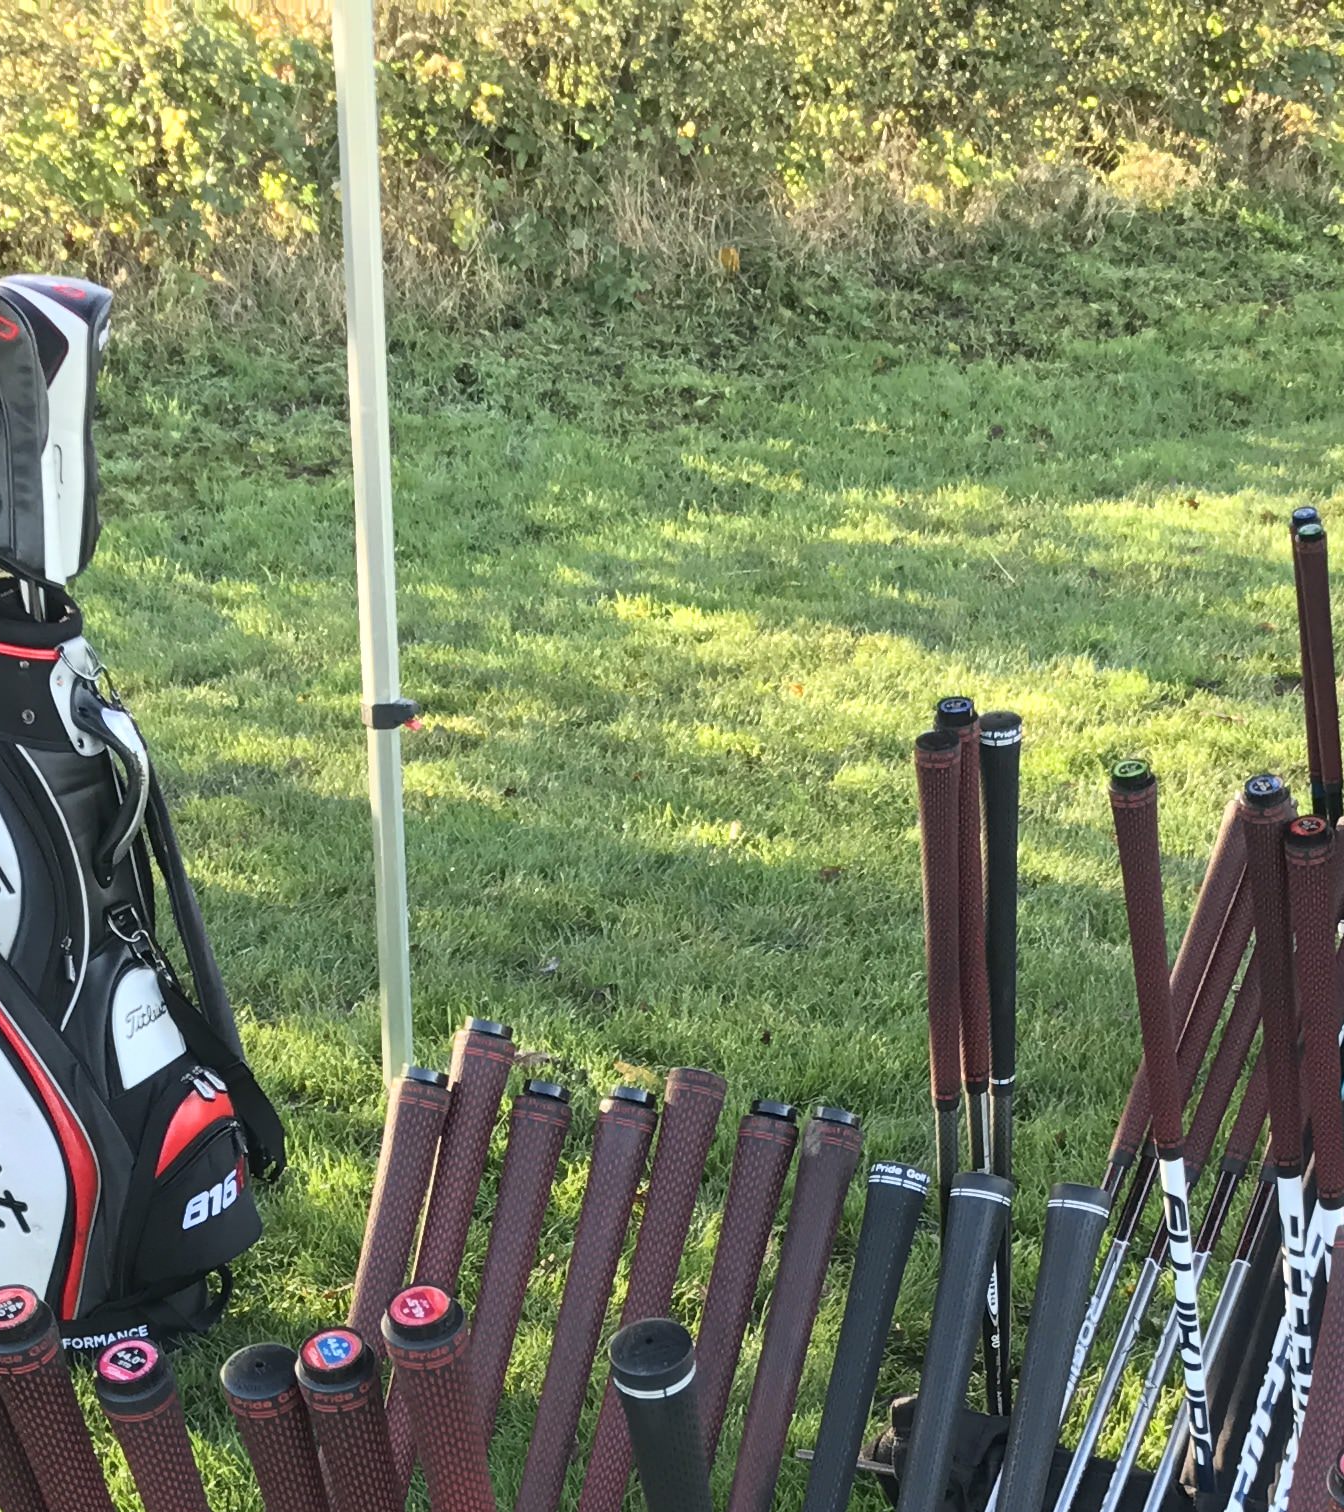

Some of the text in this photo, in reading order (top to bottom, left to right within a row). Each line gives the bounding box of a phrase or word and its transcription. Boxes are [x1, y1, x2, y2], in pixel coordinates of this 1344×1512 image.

[875, 1162, 927, 1182] Pride Golf
[182, 1169, 237, 1230] 816
